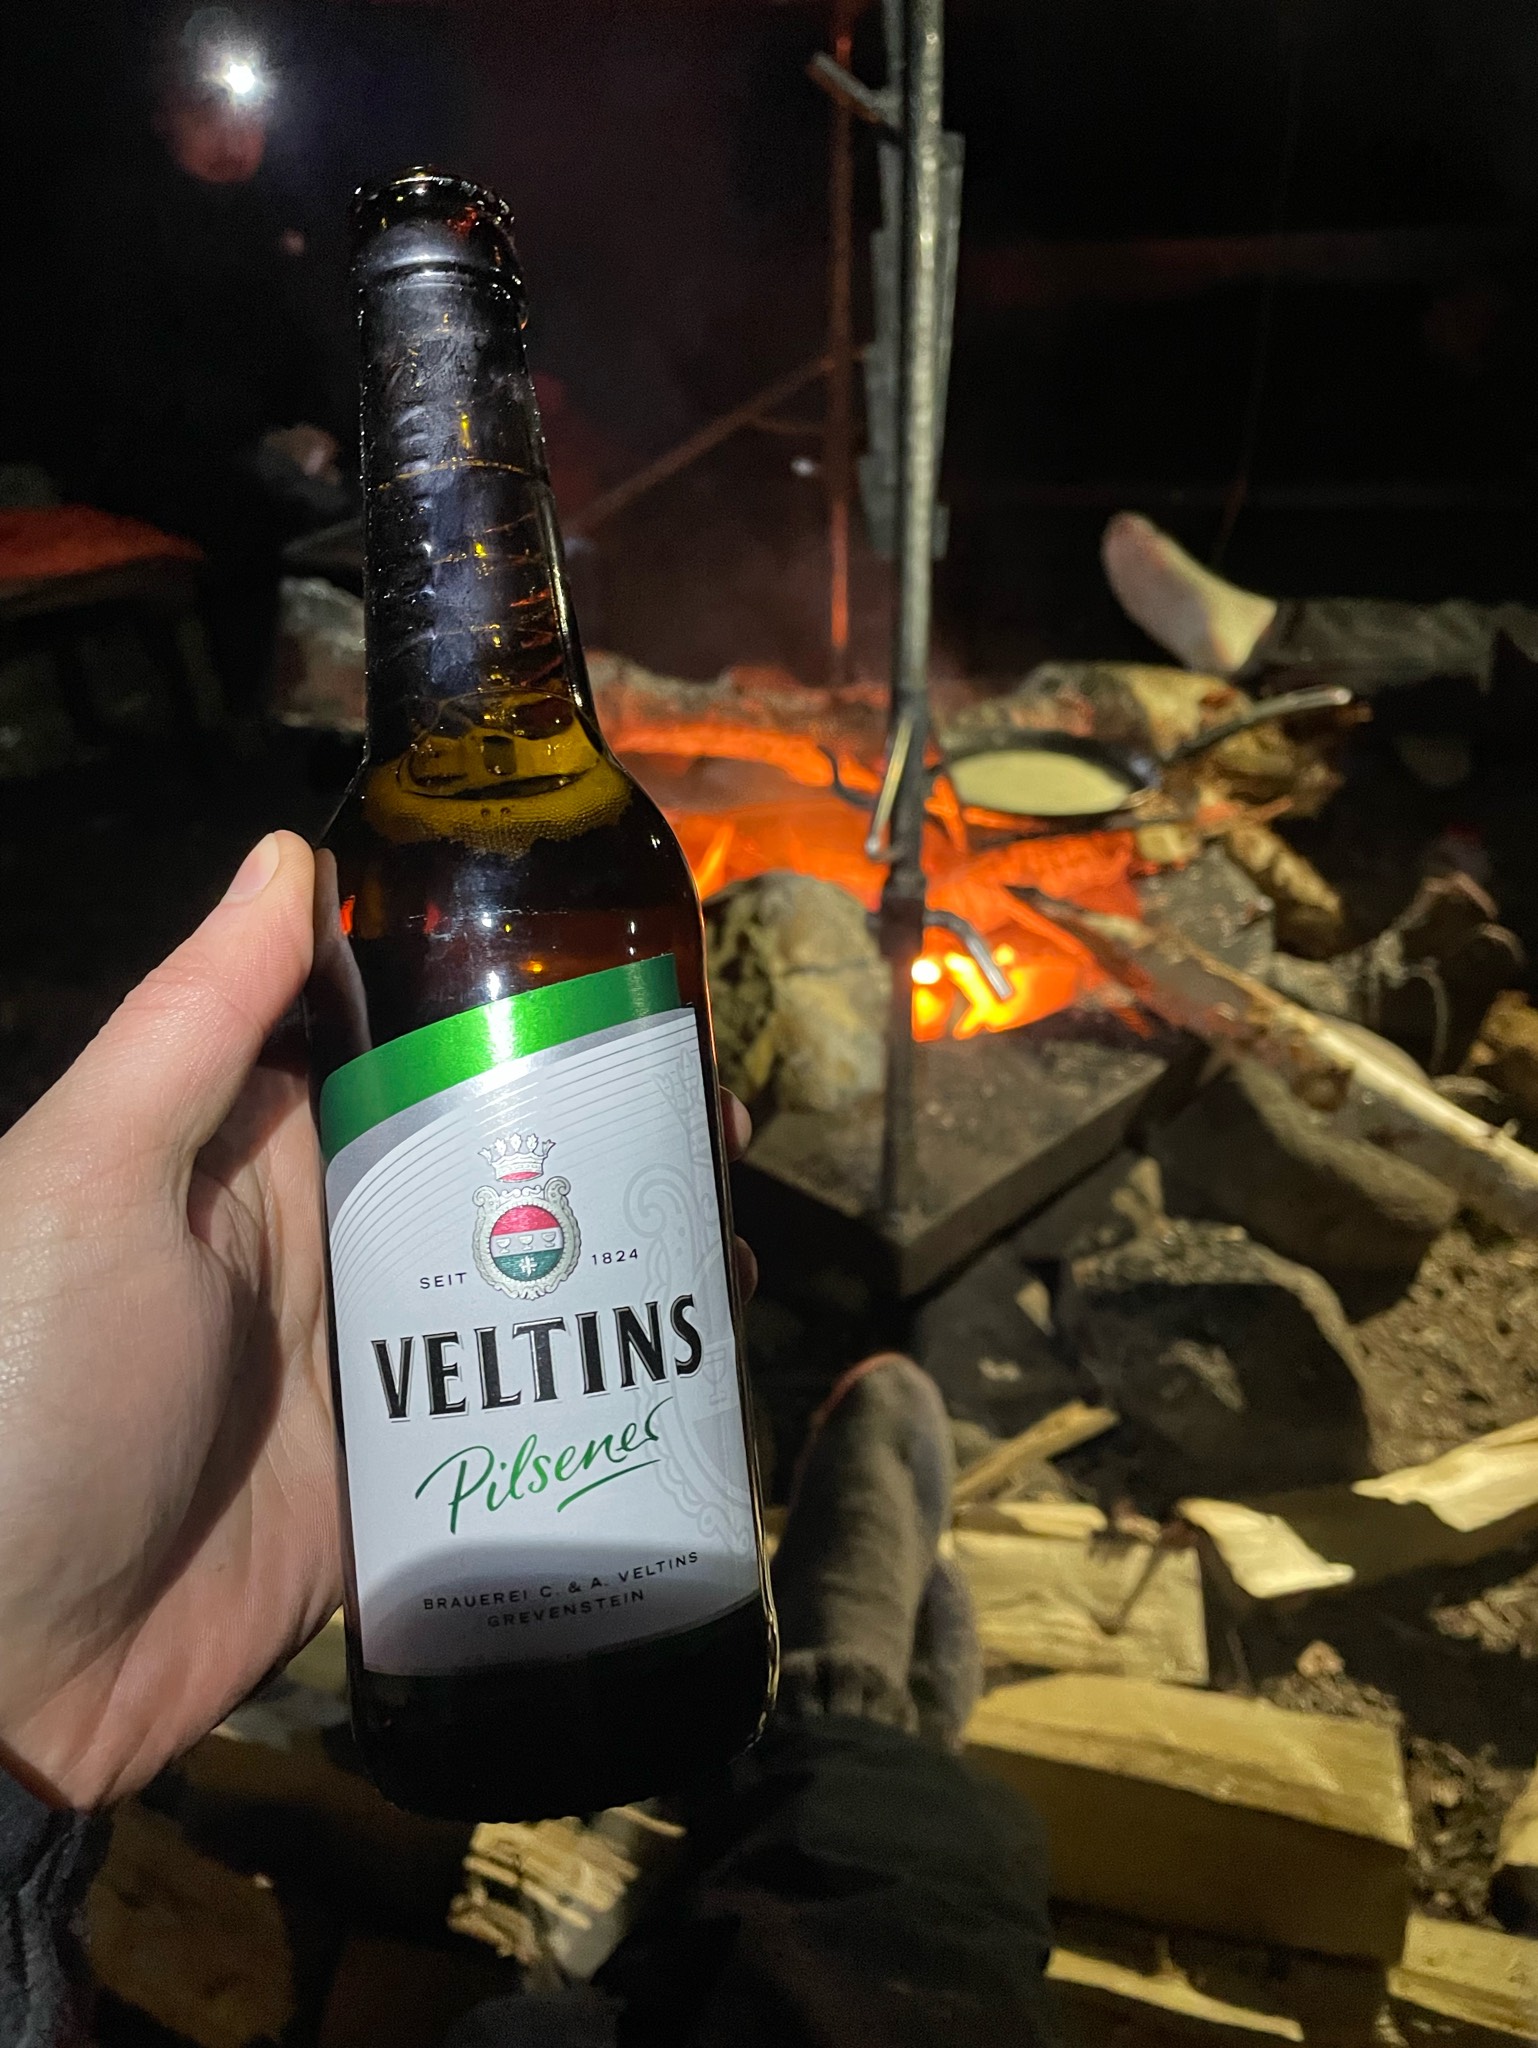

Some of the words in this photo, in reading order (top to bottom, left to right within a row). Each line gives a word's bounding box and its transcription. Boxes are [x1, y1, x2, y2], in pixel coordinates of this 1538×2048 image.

[419, 1272, 468, 1290] SEIT
[592, 1249, 639, 1266] 1824
[371, 1293, 703, 1423] VELTINS
[415, 1398, 674, 1535] Pilsener
[423, 1590, 528, 1610] BRAUEREI
[567, 1581, 581, 1593] &
[618, 1551, 699, 1583] VELTINS
[486, 1589, 644, 1628] GREVENSTEIN
